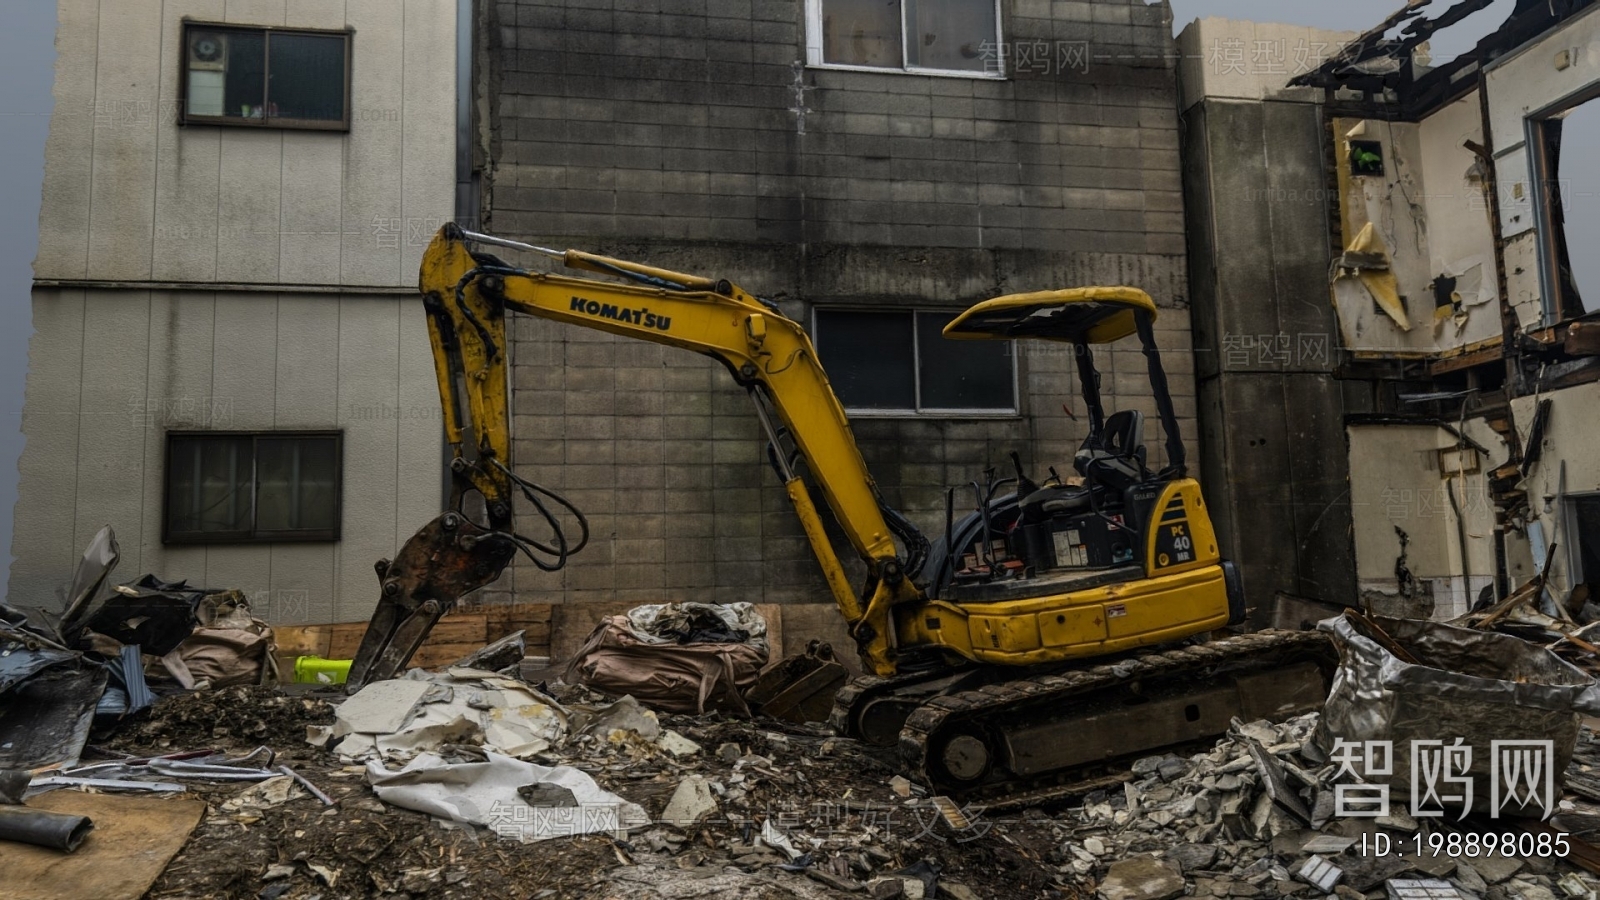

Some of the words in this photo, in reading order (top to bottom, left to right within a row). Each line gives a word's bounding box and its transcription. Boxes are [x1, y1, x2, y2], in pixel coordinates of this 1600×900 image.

[570, 296, 671, 330] KOMATSU
[1170, 525, 1185, 537] PC
[1173, 536, 1191, 551] 40
[1176, 552, 1190, 562] MR
